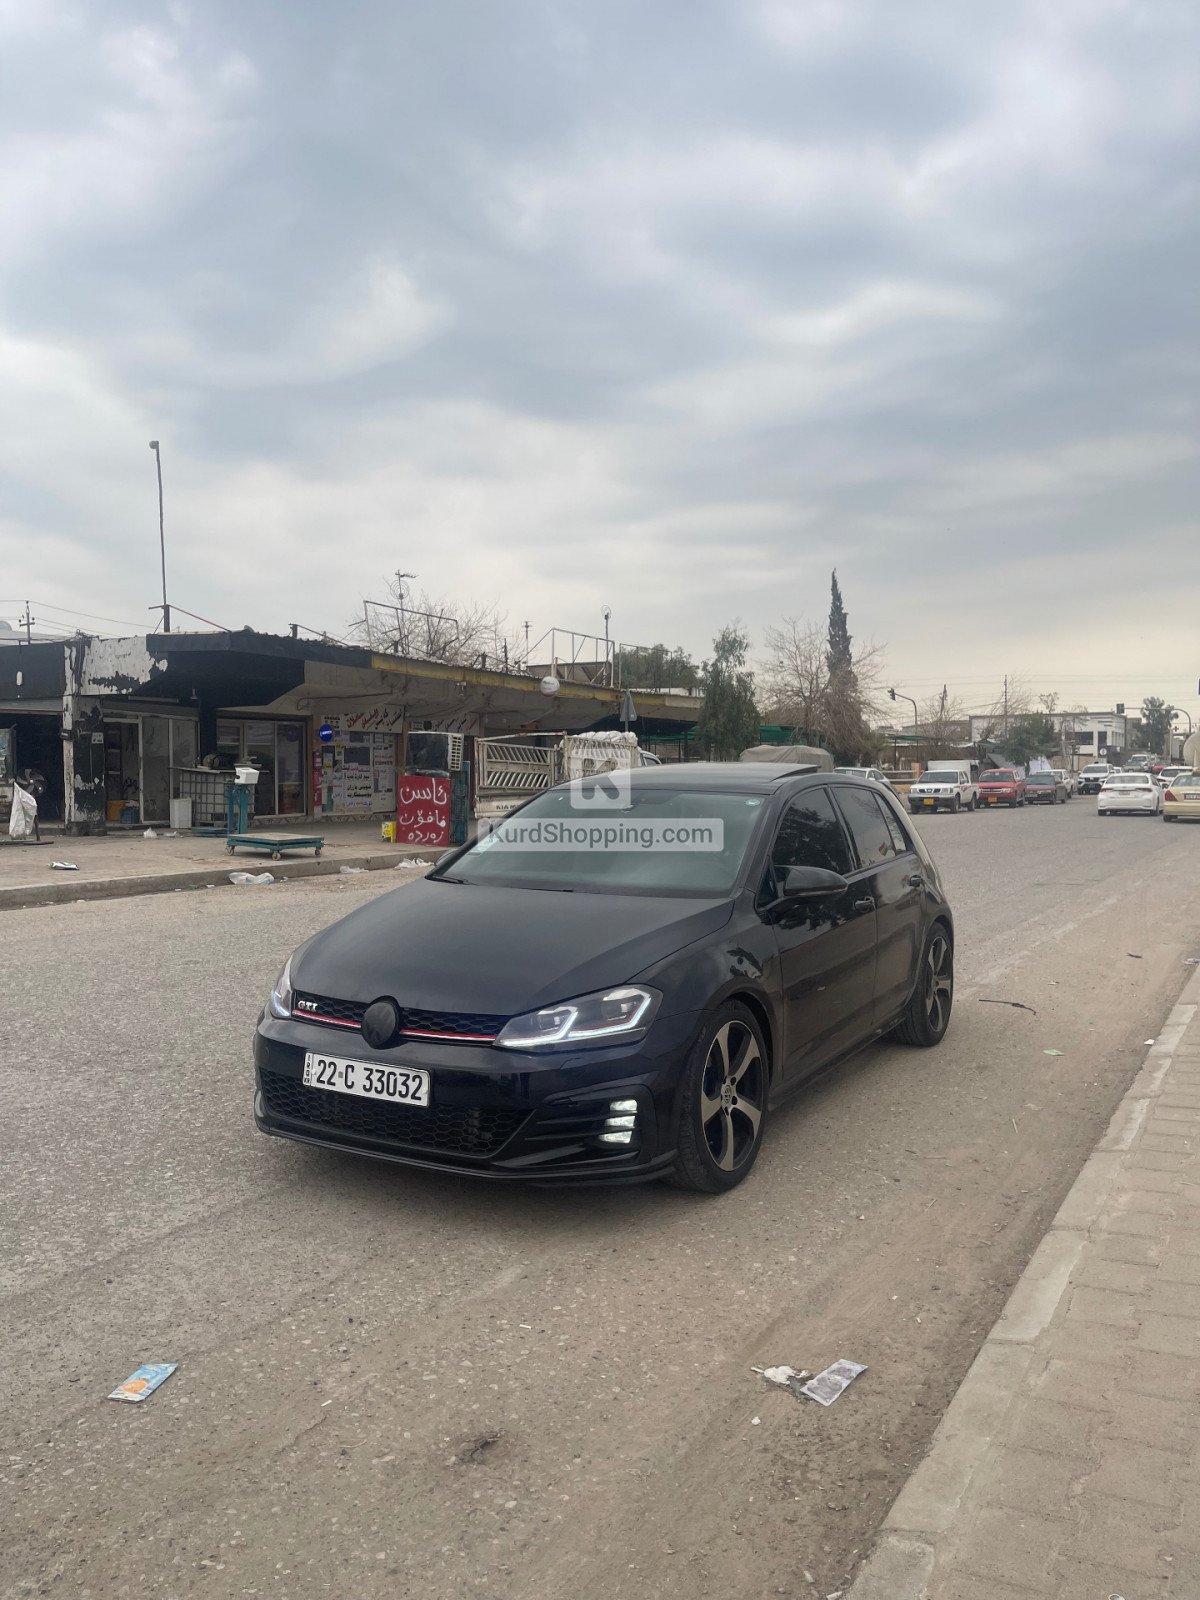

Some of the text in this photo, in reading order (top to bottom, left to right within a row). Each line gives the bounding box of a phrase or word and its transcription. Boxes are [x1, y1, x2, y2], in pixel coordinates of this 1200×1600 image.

[400, 778, 447, 805] ئاسن
[298, 1000, 318, 1012] GTI
[316, 1059, 423, 1101] 22 C 33032
